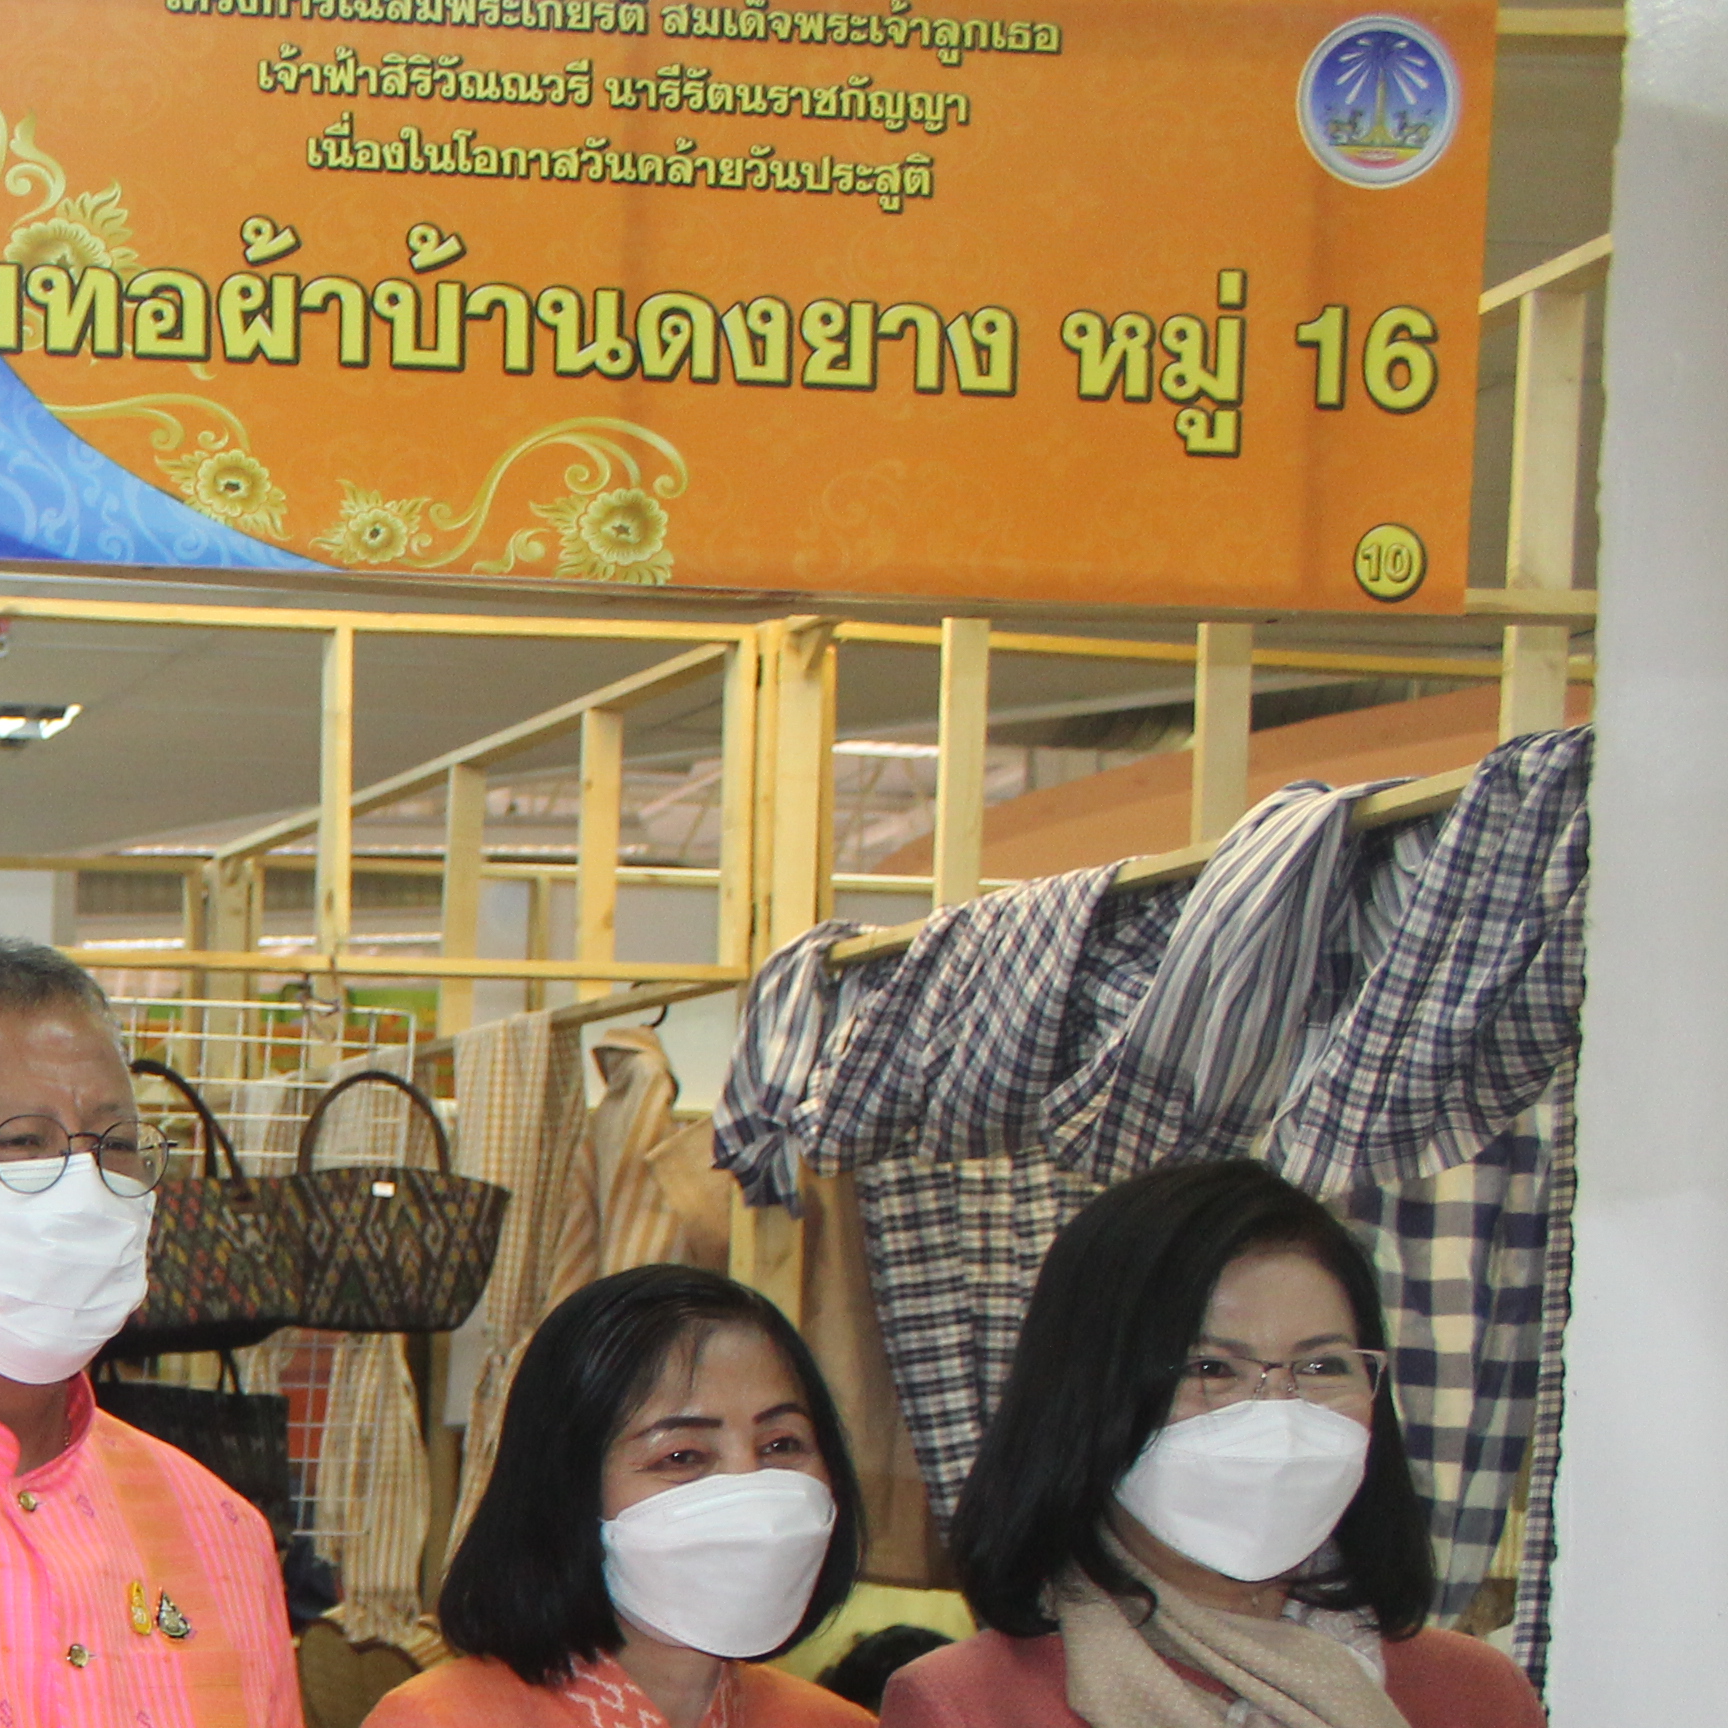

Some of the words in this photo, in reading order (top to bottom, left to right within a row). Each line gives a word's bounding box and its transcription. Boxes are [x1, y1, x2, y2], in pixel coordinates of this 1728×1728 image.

[165, 0, 649, 35] งการเฉลมพระเกยรต
[660, 0, 1062, 65] สมเด็จพระเจ้าลูกเธอ
[257, 42, 593, 105] เจ้าฟ้าสิริวัณณวรี
[604, 63, 970, 132] นารีรัตนราชกัญญา
[306, 110, 934, 213] เนื่องในโอกาสวันคล้ายวันประสูติ
[1060, 268, 1246, 457] หมู่
[1295, 304, 1438, 414] 16
[1361, 542, 1413, 583] 10
